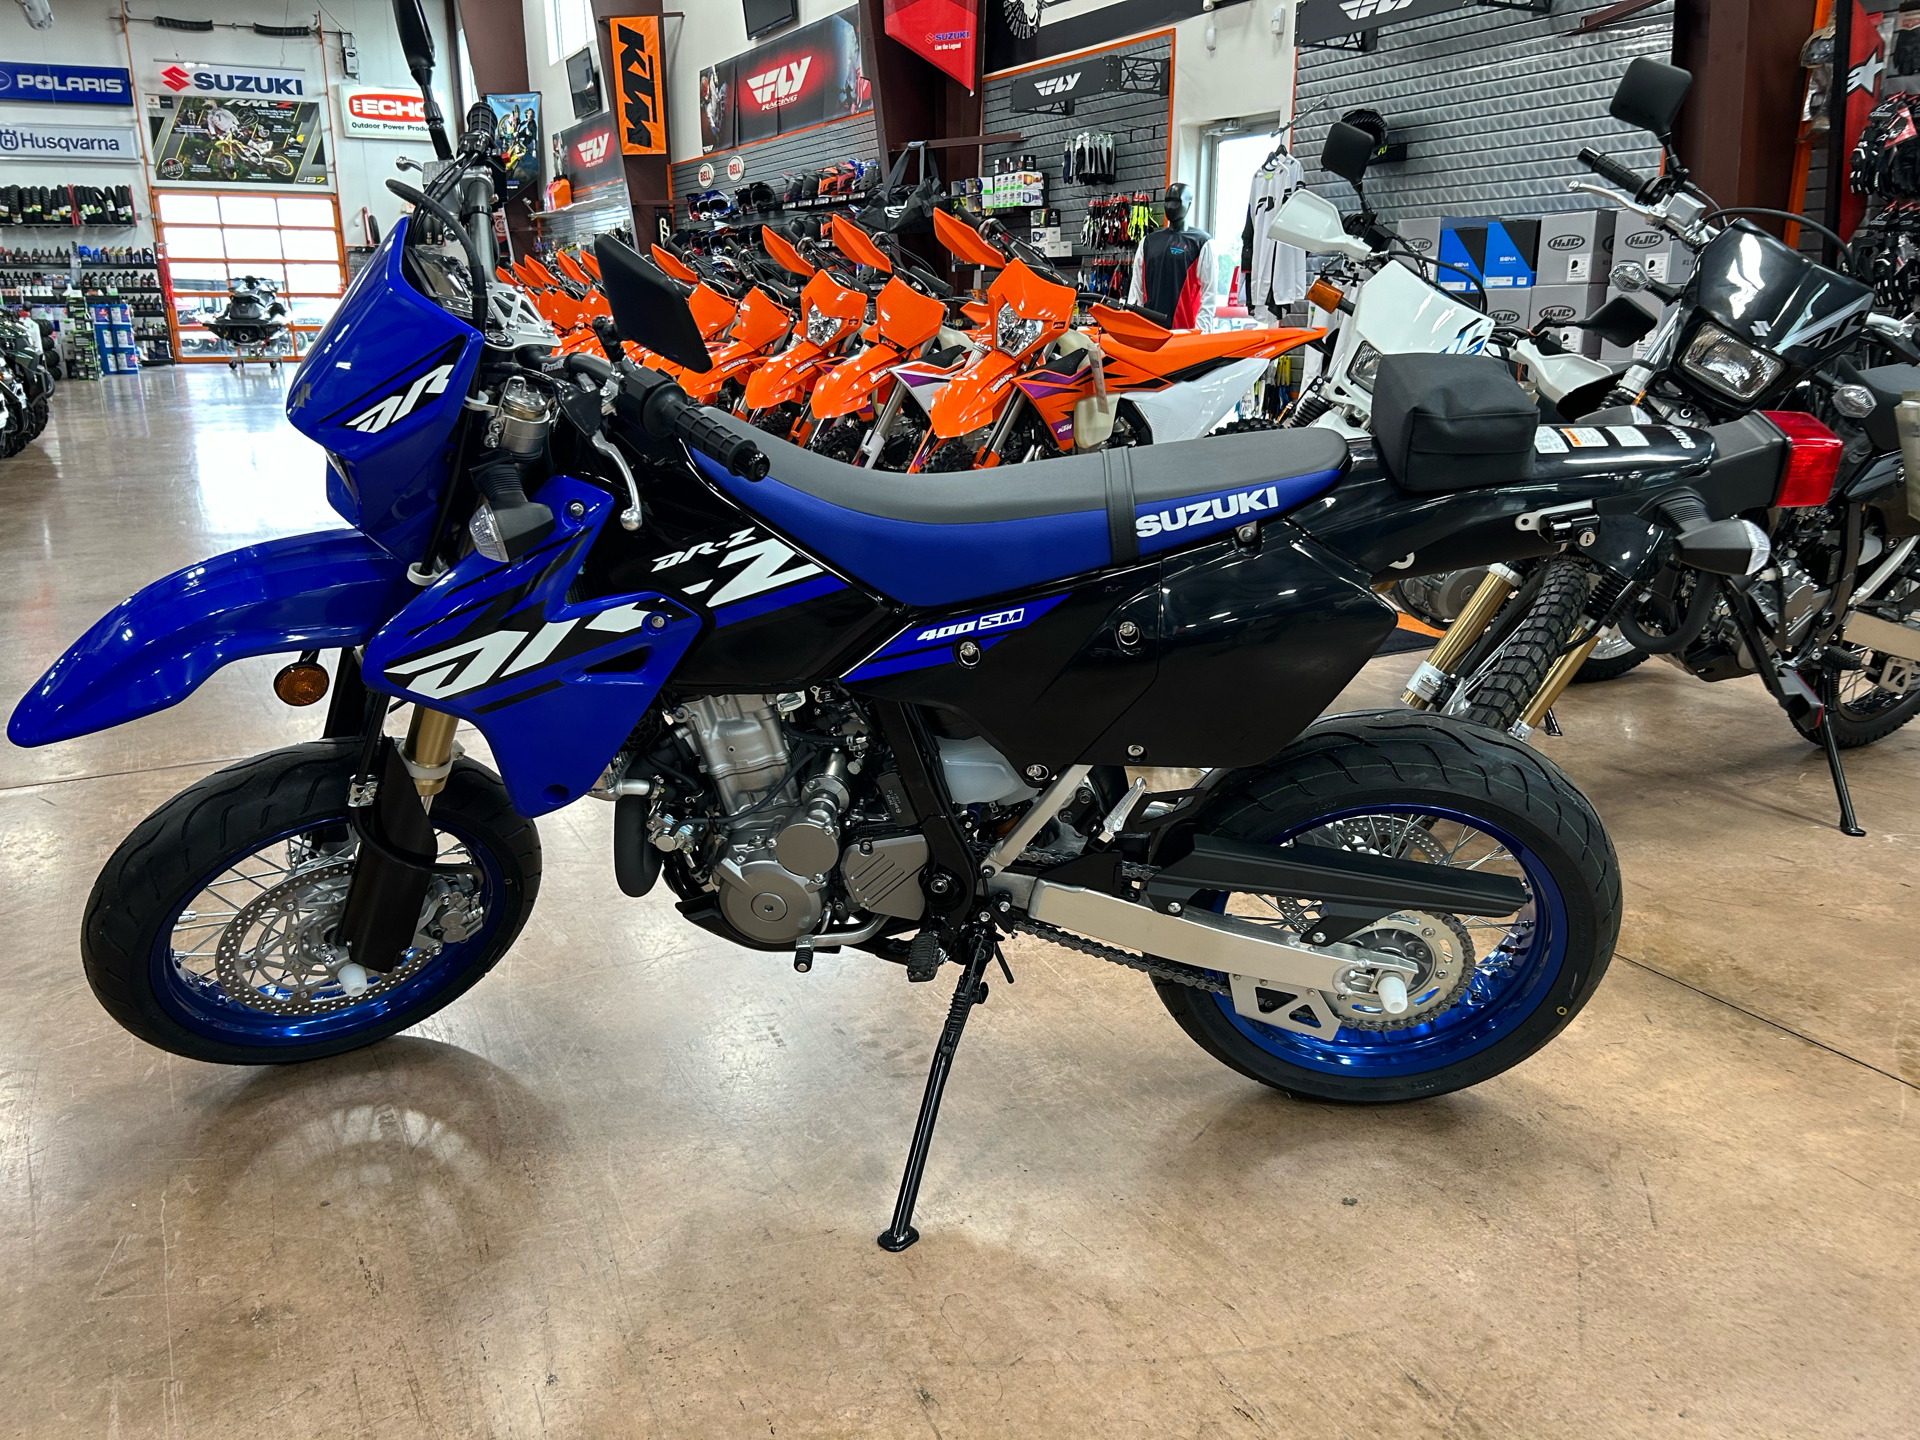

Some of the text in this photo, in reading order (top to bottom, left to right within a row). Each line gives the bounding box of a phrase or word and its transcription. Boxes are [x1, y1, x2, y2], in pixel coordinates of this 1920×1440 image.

[935, 31, 970, 41] SUZUKI
[17, 74, 123, 93] POLARIS
[193, 72, 303, 96] SUZUKI
[617, 23, 658, 148] KTM
[747, 56, 812, 104] FLY
[1034, 72, 1082, 97] FLY
[761, 94, 798, 111] RACING
[352, 121, 380, 130] Outdoor
[383, 123, 405, 131] Power
[20, 132, 120, 153] Husqvarna
[577, 132, 610, 163] FLY
[700, 170, 711, 182] BELL
[728, 163, 741, 175] BELL
[1552, 237, 1581, 248] HJC
[1630, 234, 1659, 245] HJC
[1057, 423, 1073, 434] KTM
[1136, 486, 1279, 538] SUZUKI
[651, 526, 757, 573] DR-Z
[917, 609, 1023, 641] 400 SM
